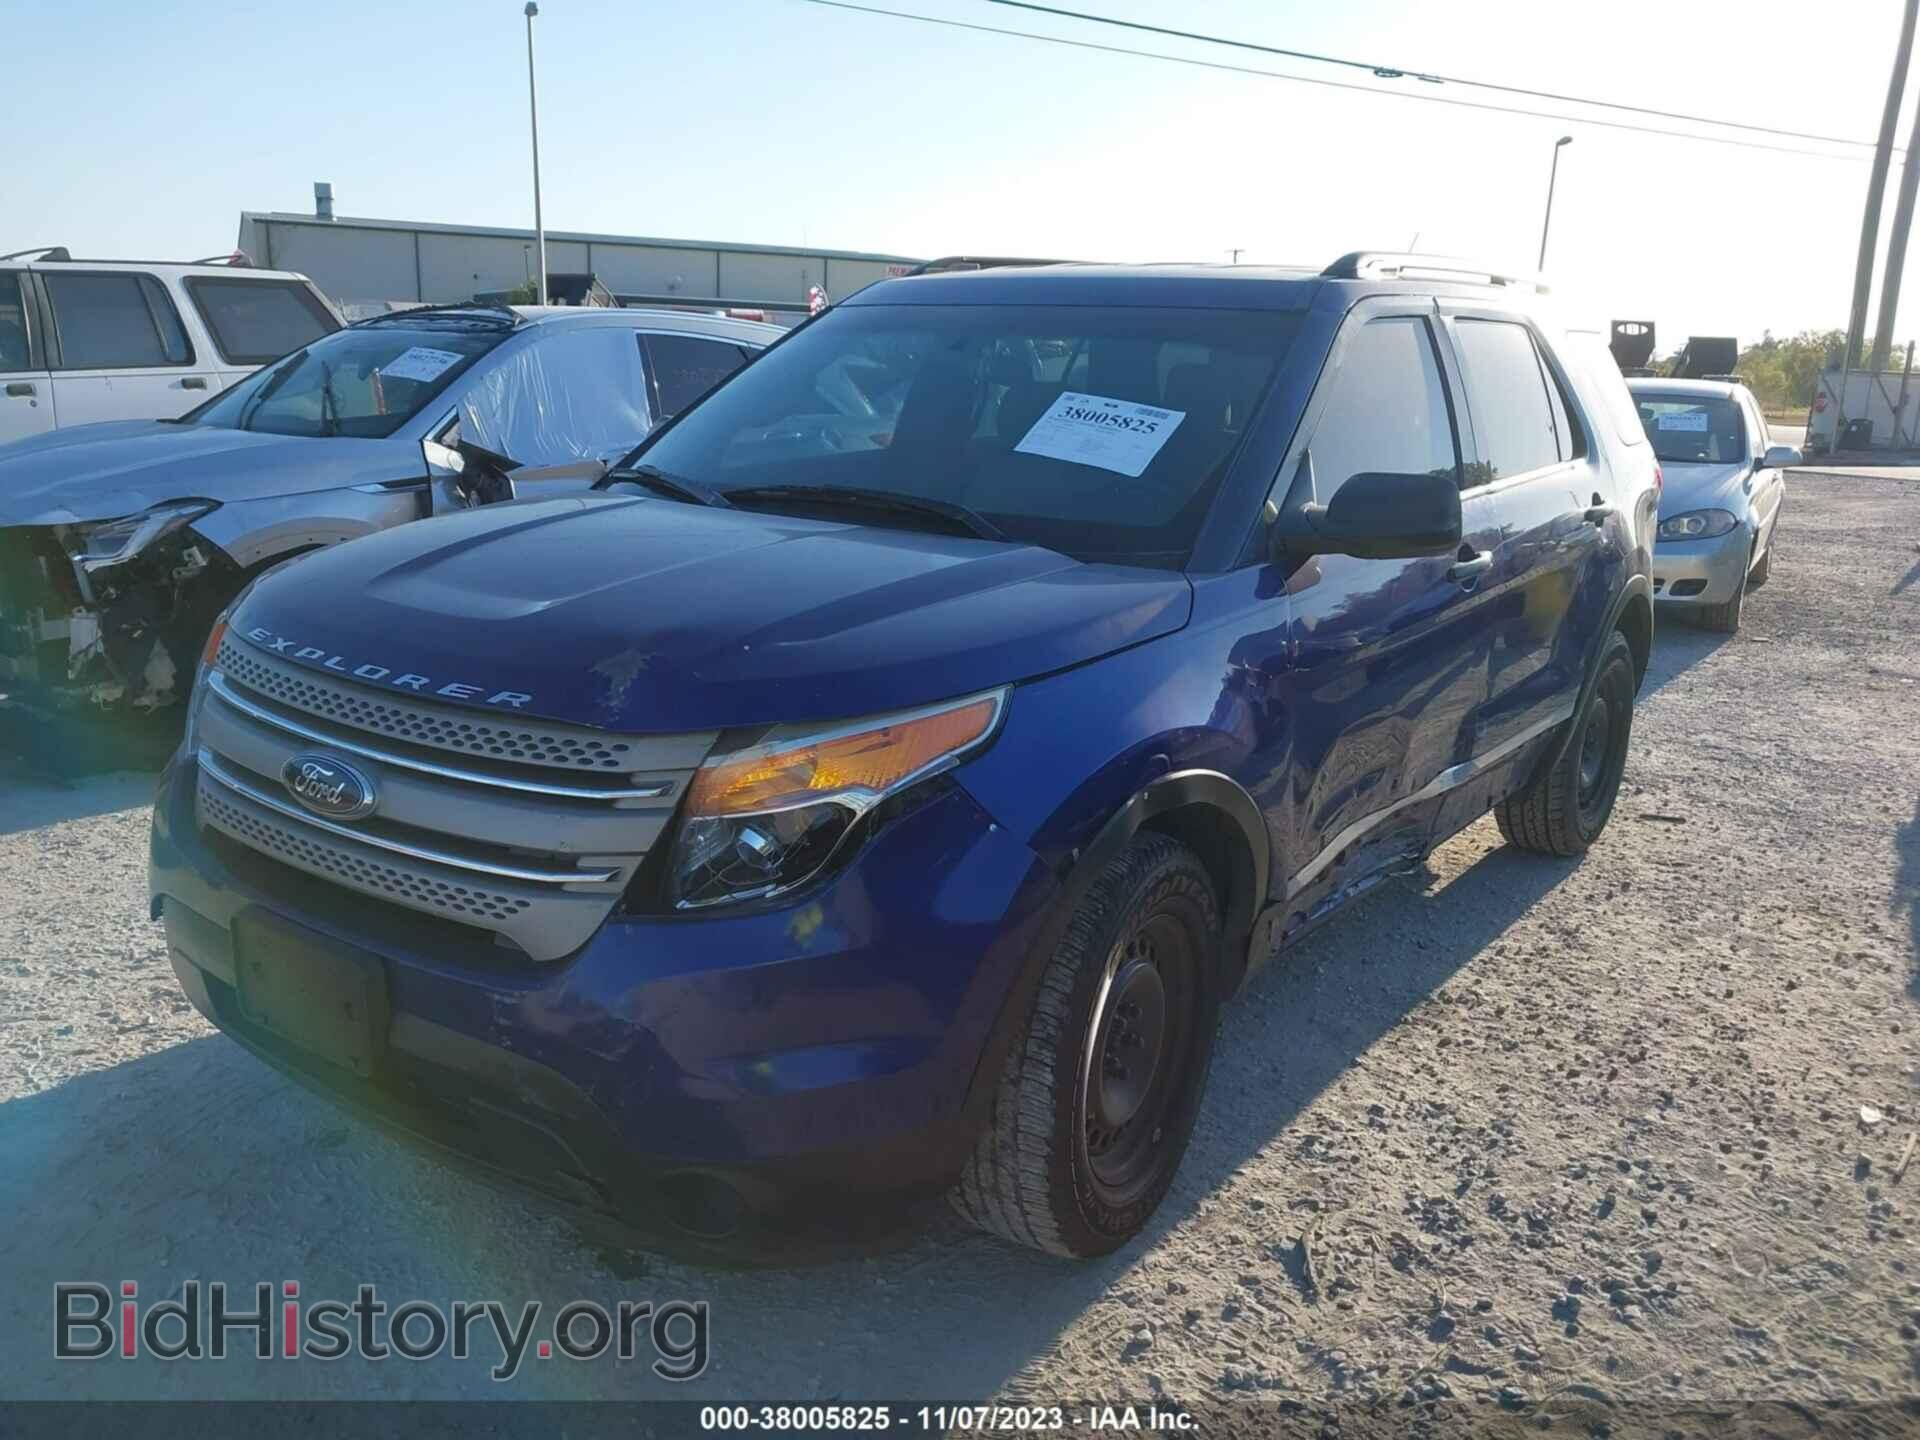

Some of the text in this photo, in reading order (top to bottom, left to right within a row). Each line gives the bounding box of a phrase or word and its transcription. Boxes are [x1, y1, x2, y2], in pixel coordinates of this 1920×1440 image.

[1057, 406, 1159, 434] 38005825
[248, 627, 533, 708] EXPLORER
[294, 762, 345, 805] Ford
